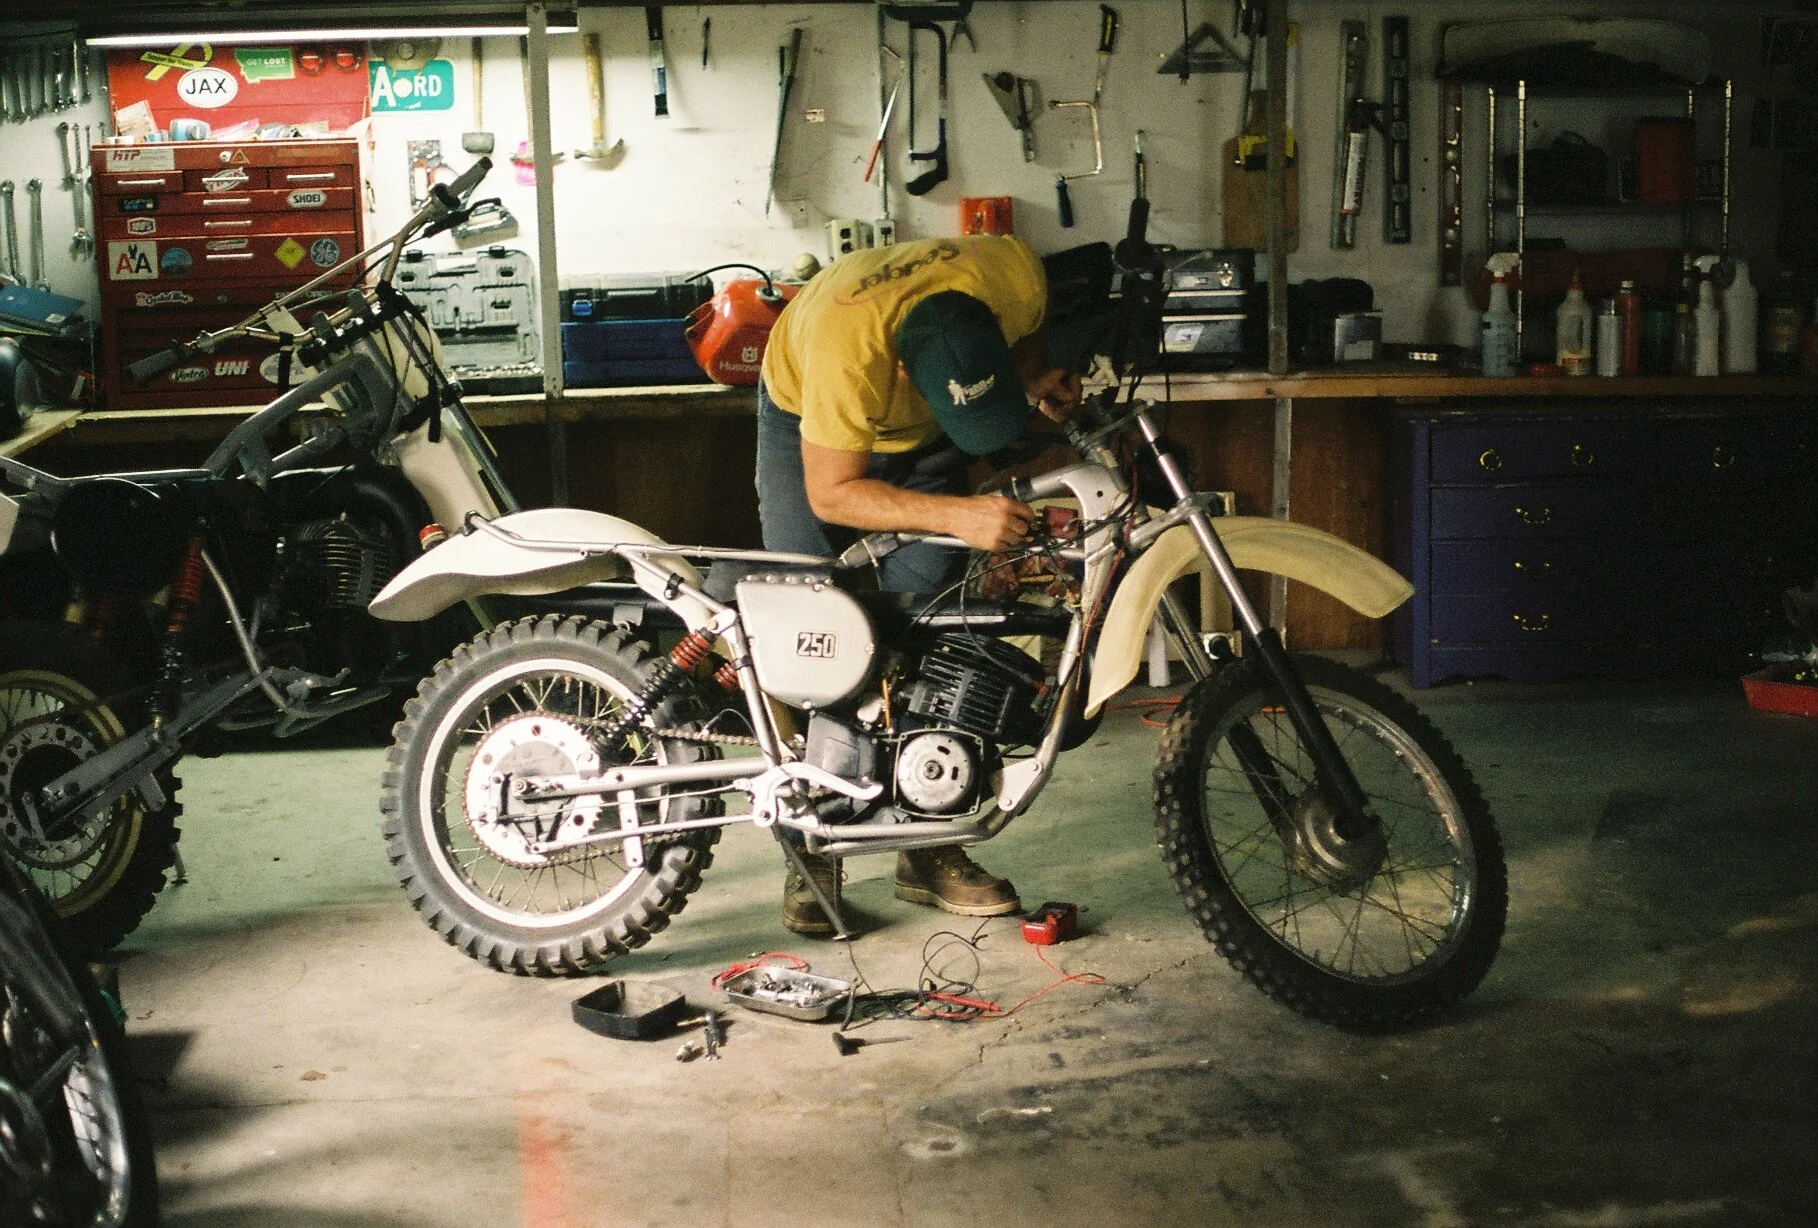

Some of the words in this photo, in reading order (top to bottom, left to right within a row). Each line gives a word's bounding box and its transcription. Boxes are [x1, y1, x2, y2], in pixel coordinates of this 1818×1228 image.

[264, 57, 286, 65] LOST
[186, 78, 228, 95] JAX
[292, 194, 321, 204] SHOEI
[799, 633, 837, 658] 250
